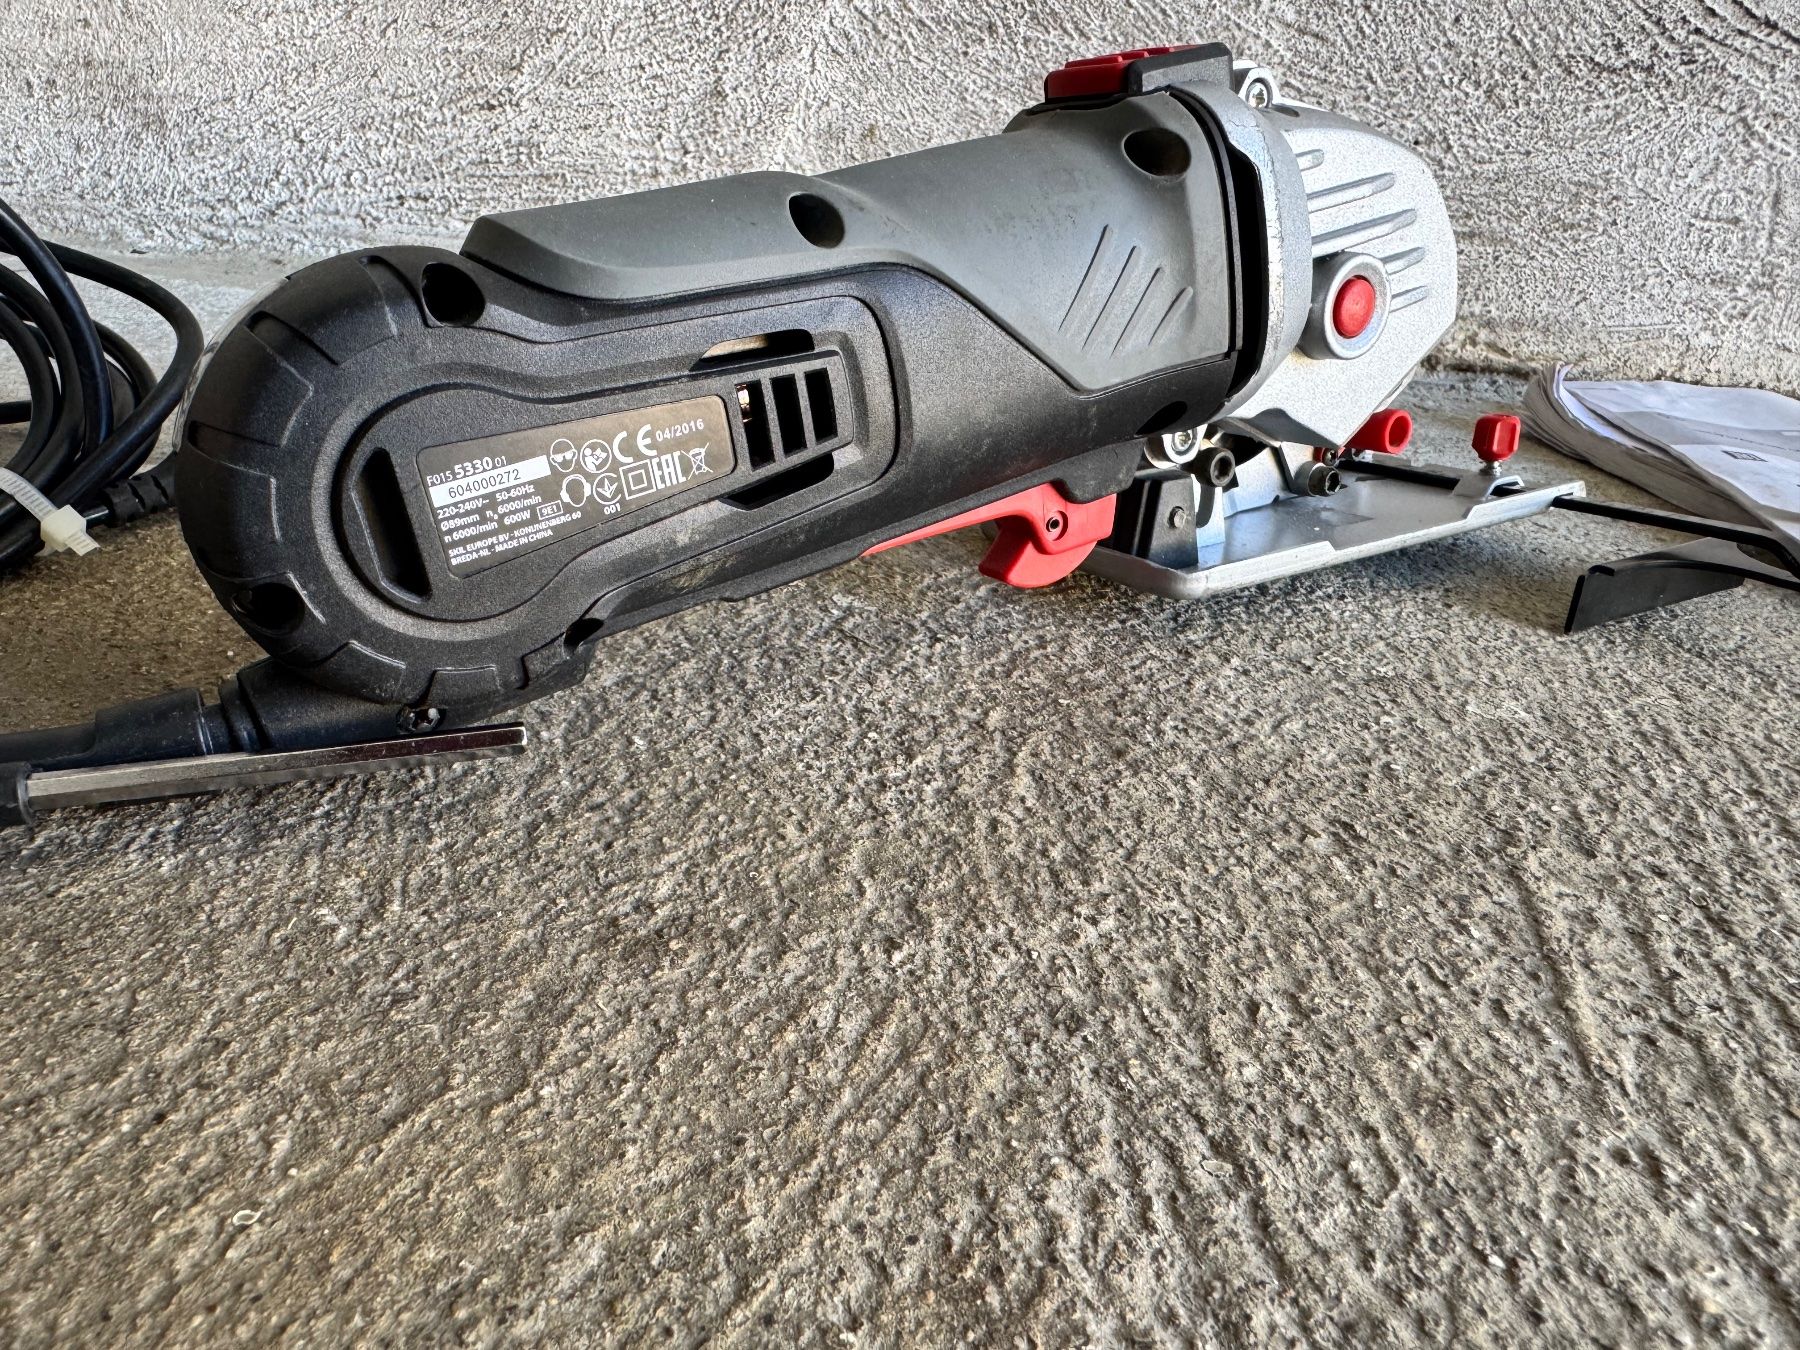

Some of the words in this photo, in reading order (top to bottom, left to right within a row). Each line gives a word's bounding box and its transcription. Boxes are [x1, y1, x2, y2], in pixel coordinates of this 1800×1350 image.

[656, 418, 705, 442] 04/2016
[427, 470, 453, 486] F015
[454, 457, 493, 478] 5330
[494, 456, 507, 467] 01
[448, 468, 521, 498] 604000272
[495, 484, 535, 502] 50-60Hz
[440, 513, 480, 531] Ø89mm
[497, 495, 542, 514] 6000/min
[541, 505, 558, 516] 9E1
[604, 503, 621, 515] 001
[448, 546, 466, 557] SKIL
[467, 536, 498, 552] EUROPE
[499, 532, 510, 544] BV
[572, 511, 582, 520] 60
[453, 521, 498, 541] 6000/min
[504, 509, 531, 525] 600W
[451, 548, 491, 566] BREDA-NL
[495, 539, 520, 553] MADE
[519, 536, 529, 545] IN
[528, 529, 553, 543] CHINA
